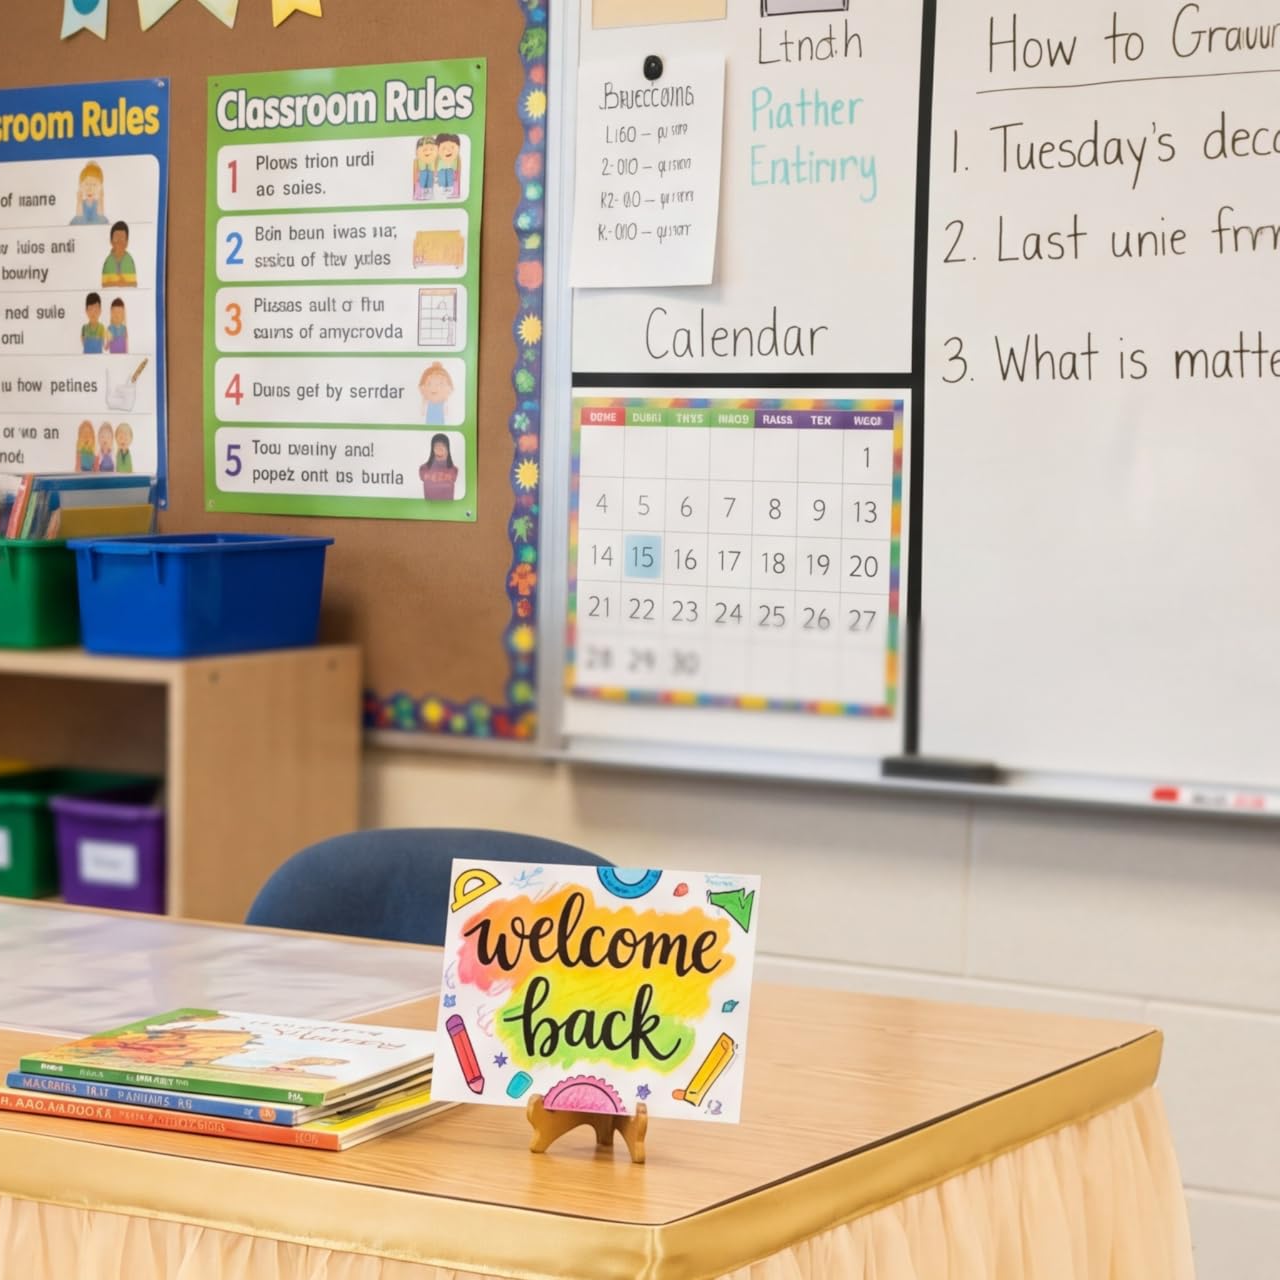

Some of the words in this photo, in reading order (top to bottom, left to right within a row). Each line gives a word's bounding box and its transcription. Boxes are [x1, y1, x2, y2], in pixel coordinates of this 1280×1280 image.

[989, 13, 1077, 73] How
[1104, 11, 1144, 64] to
[82, 97, 160, 137] Rules
[217, 88, 377, 132] Classroom
[385, 76, 474, 121] Rules
[953, 129, 969, 173] 1.
[989, 119, 1176, 190] Tuesday's
[227, 160, 238, 194] 1
[225, 231, 244, 265] 2
[944, 219, 977, 263] 2.
[998, 214, 1088, 261] Last
[301, 251, 316, 267] of
[224, 302, 242, 336] 3
[299, 323, 314, 339] of
[646, 305, 829, 359] Calendar
[942, 336, 974, 383] 3.
[995, 331, 1099, 382] What
[1119, 336, 1148, 380] is
[225, 373, 244, 406] 4
[326, 383, 343, 402] by
[225, 444, 242, 477] 5
[863, 447, 871, 468] 1
[596, 493, 608, 514] 4
[638, 495, 651, 516] 5
[680, 496, 693, 517] 6
[723, 497, 737, 518] 7
[768, 498, 782, 520] 8
[812, 499, 826, 521] 9
[854, 501, 878, 523] 13
[591, 544, 613, 567] 14
[632, 546, 654, 568] 15
[674, 548, 697, 570] 16
[718, 550, 741, 572] 17
[762, 552, 786, 574] 18
[807, 553, 830, 576] 19
[849, 555, 879, 577] 20
[588, 596, 610, 617] 21
[629, 598, 655, 620] 22
[672, 600, 698, 622] 23
[715, 602, 743, 625] 24
[758, 605, 786, 627] 25
[803, 607, 831, 630] 26
[849, 609, 876, 632] 27
[464, 891, 722, 977] welcome
[503, 976, 682, 1061] back
